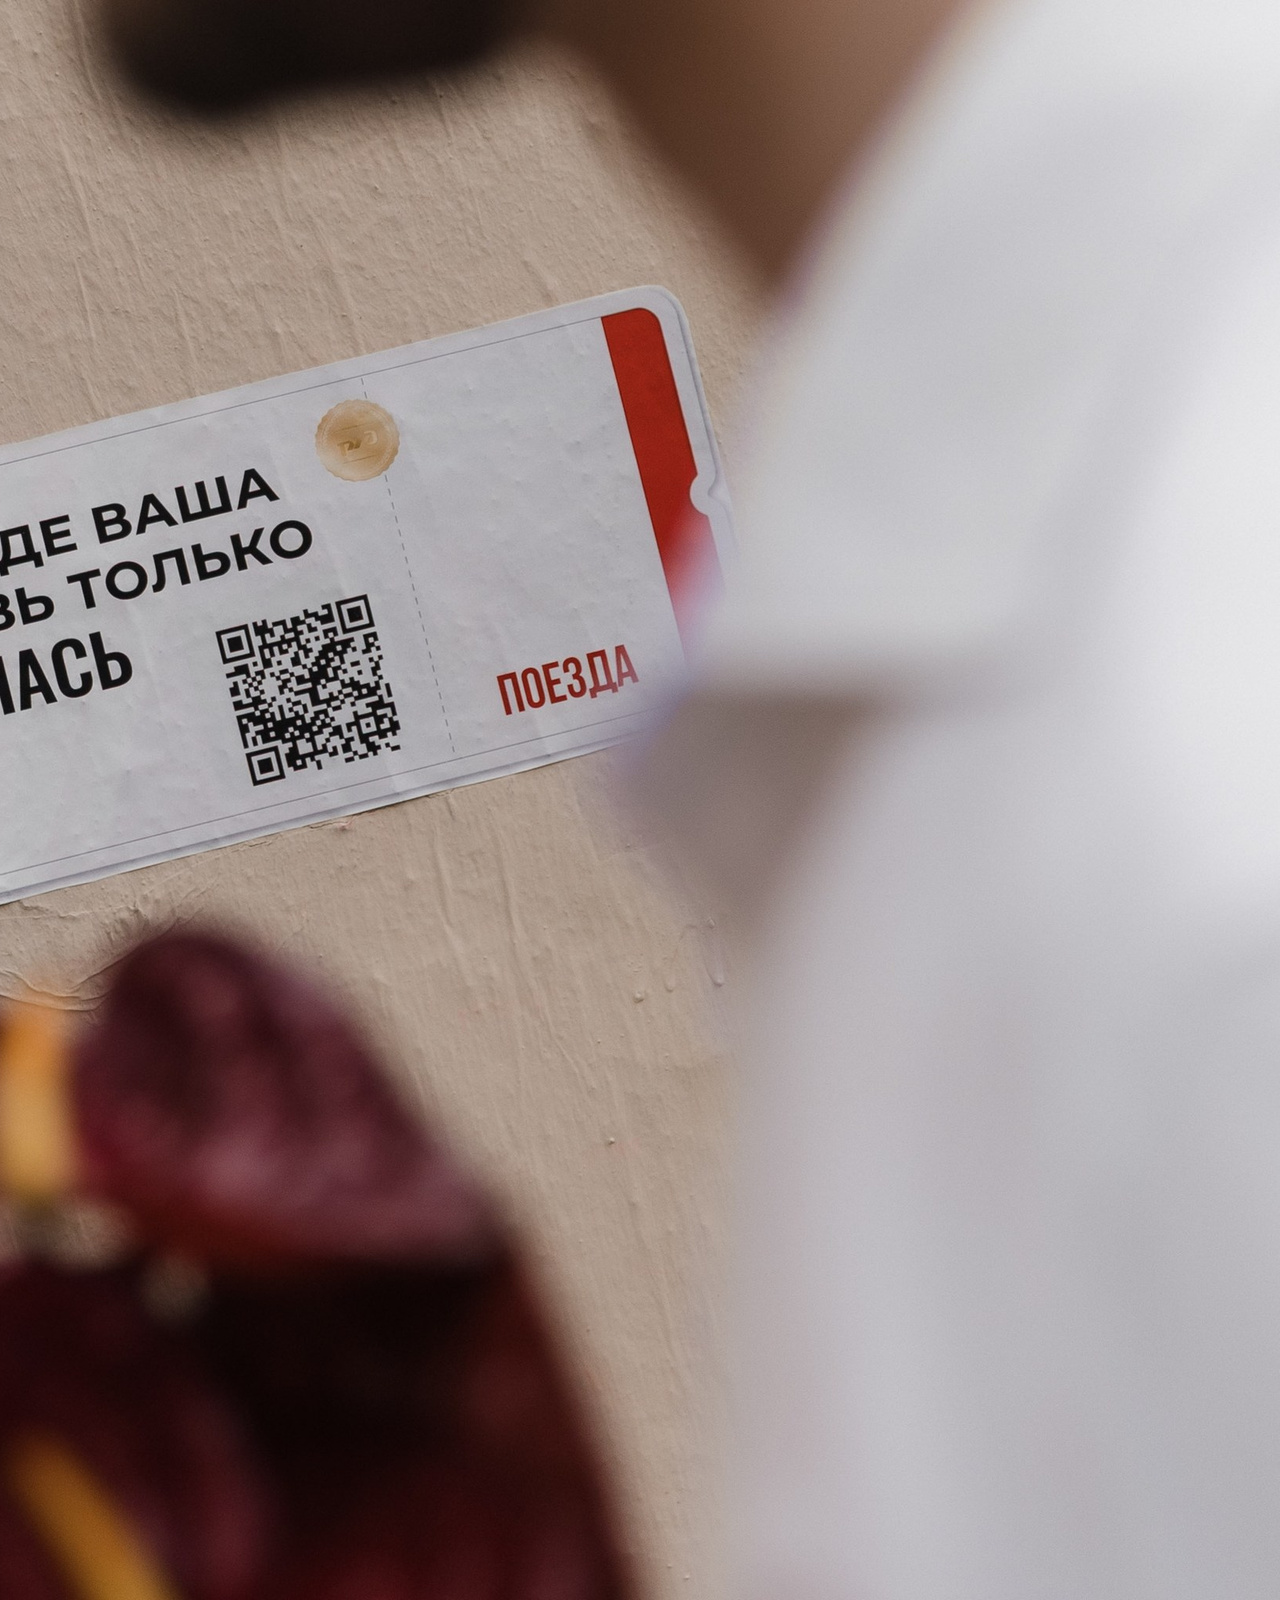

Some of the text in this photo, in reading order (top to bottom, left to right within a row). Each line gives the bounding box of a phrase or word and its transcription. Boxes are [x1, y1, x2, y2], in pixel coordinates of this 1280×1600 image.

[91, 467, 280, 545] ВАША
[65, 519, 313, 610] ТОЛЬКО
[496, 644, 639, 716] ПОЕЗДА
